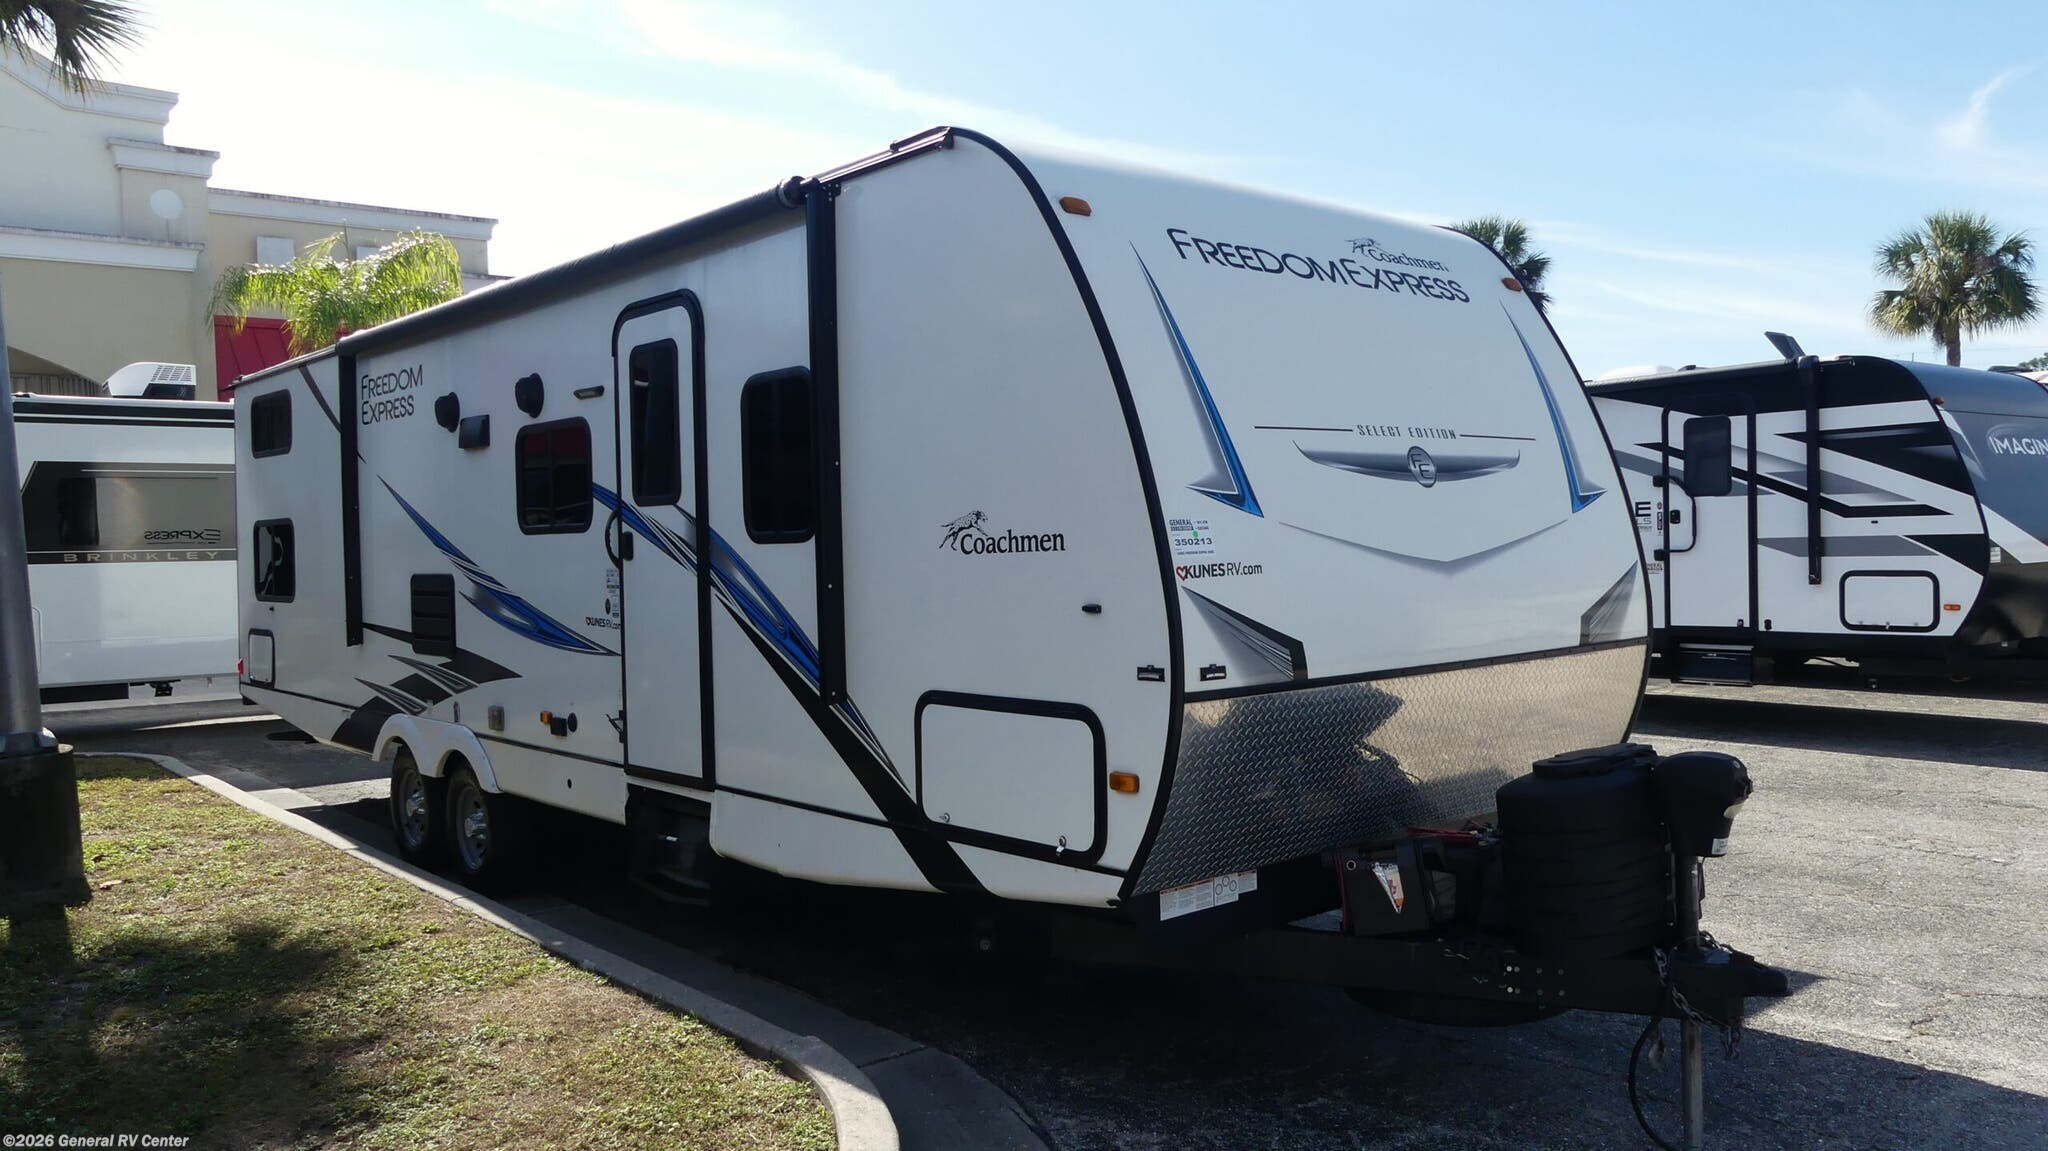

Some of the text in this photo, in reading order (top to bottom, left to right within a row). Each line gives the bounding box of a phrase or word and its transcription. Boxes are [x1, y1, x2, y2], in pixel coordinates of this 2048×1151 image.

[1368, 248, 1450, 272] Coachmen
[361, 364, 423, 401] FREEDOM
[361, 394, 414, 425] EXPRESS
[1357, 424, 1457, 440] SELECT EDITION
[960, 529, 1066, 555] Coachmen
[1174, 537, 1213, 547] 350213
[63, 551, 219, 563] BRINKLEY
